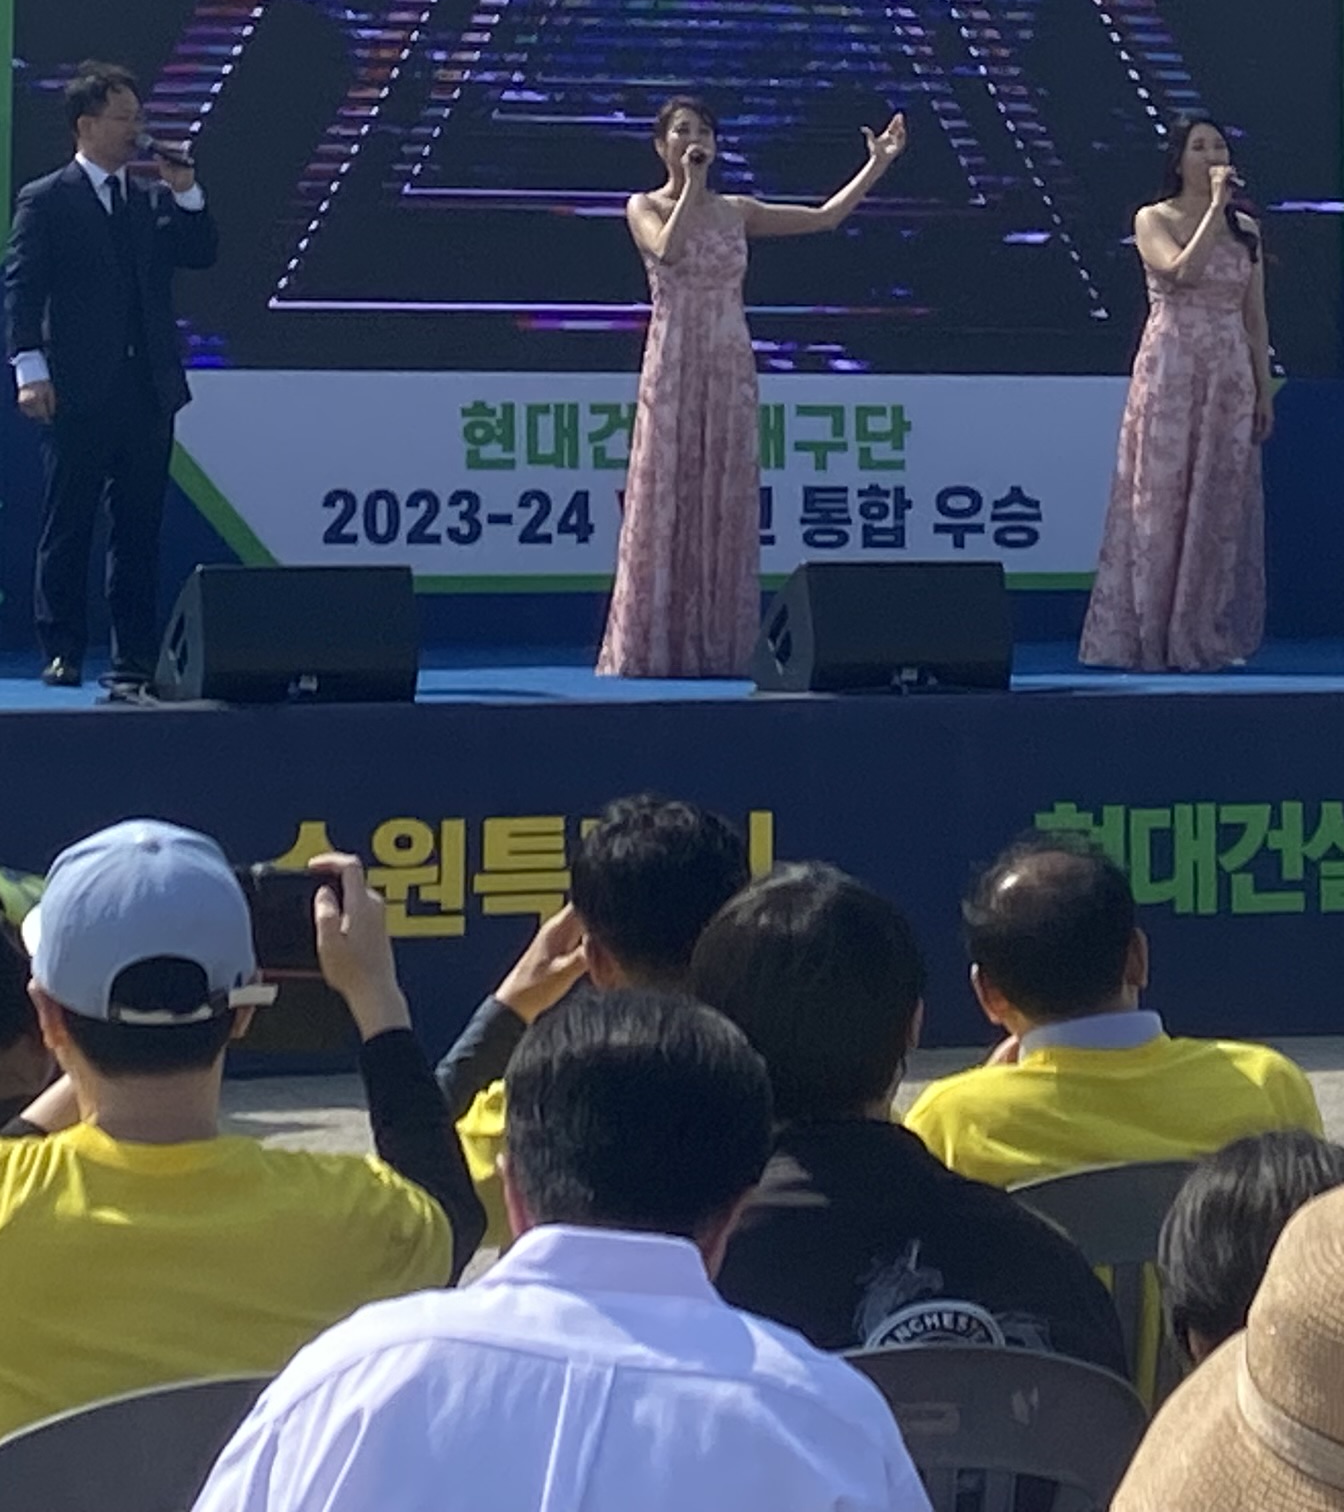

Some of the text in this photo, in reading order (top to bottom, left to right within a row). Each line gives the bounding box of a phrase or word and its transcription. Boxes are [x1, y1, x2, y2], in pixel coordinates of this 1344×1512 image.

[461, 400, 637, 471] 현대건
[323, 489, 595, 547] 2023-24
[799, 484, 913, 550] 통합
[933, 486, 1043, 550] 우승
